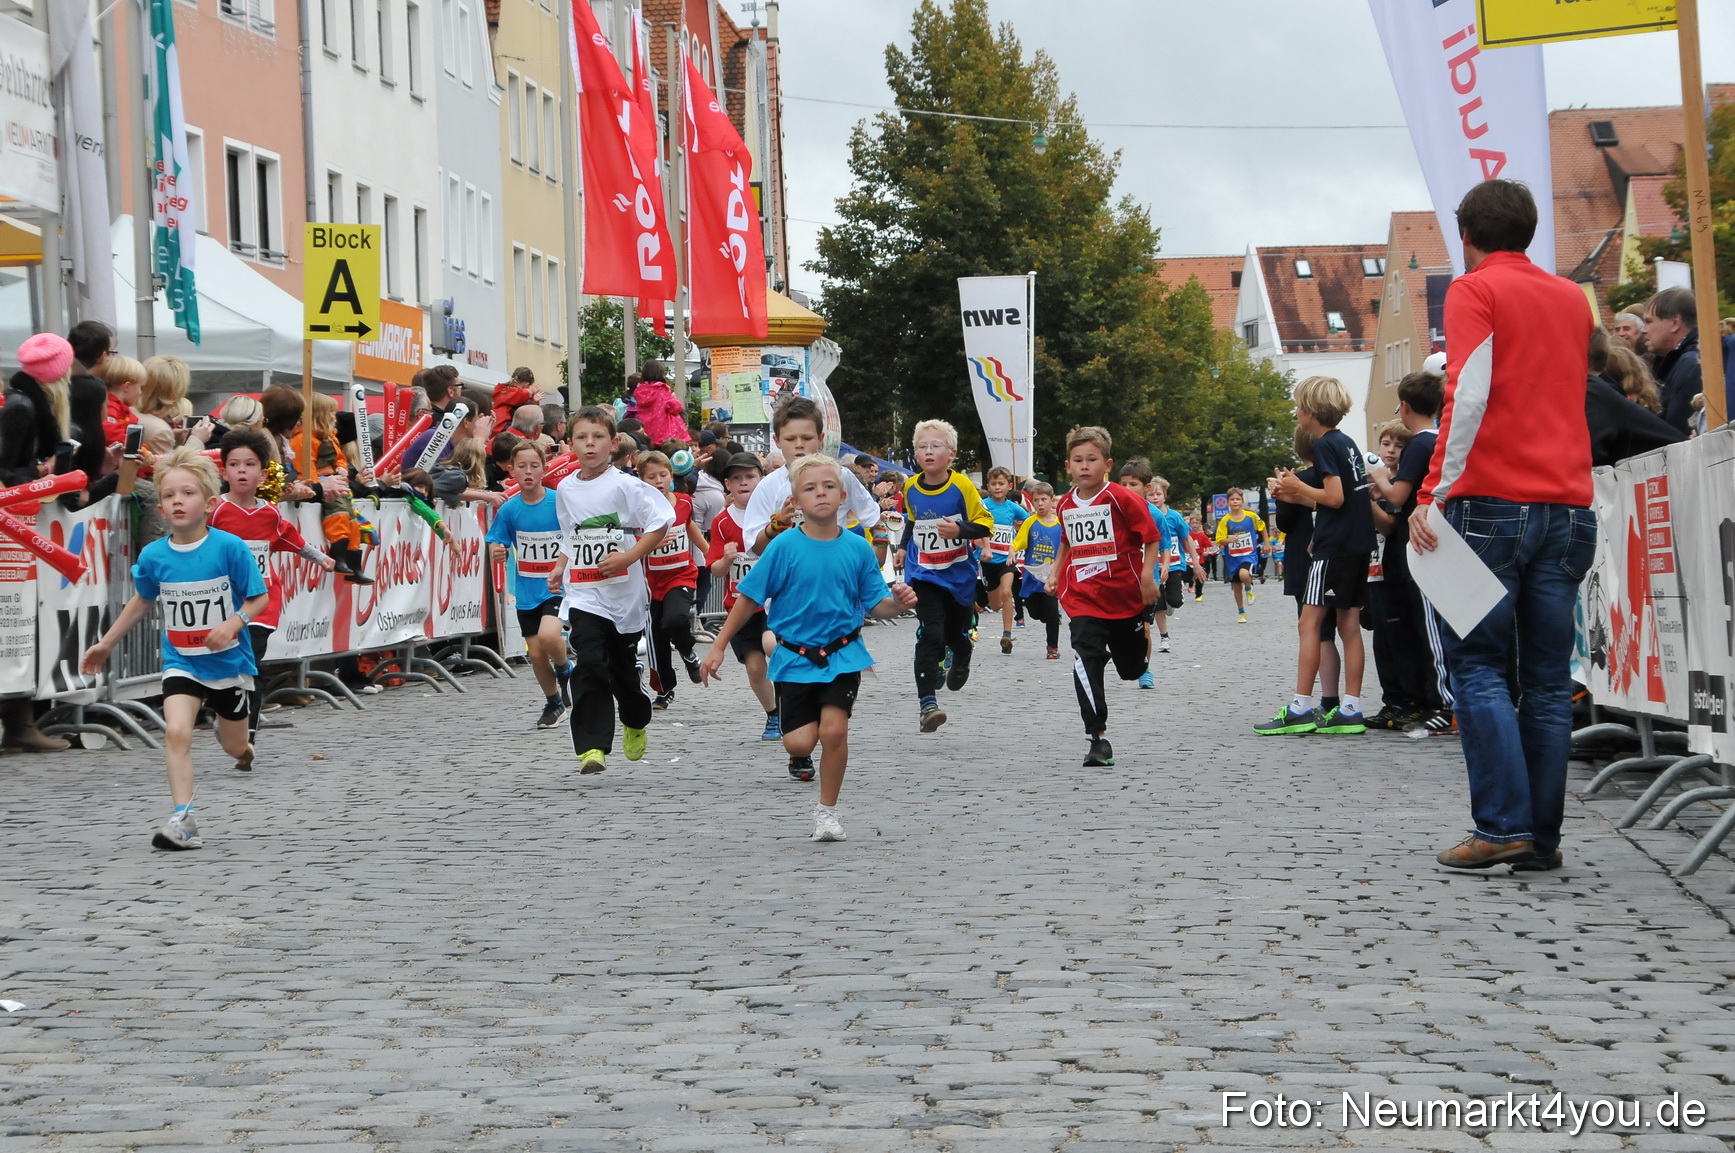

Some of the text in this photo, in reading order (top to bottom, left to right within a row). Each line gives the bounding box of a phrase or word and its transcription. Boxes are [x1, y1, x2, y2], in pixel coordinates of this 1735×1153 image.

[313, 228, 371, 249] Block
[319, 259, 363, 314] A
[427, 431, 445, 455] BMW
[1076, 511, 1101, 519] Neumarkt
[5, 519, 26, 534] BKK
[1068, 519, 1108, 543] 7034
[521, 542, 560, 560] 7112
[182, 586, 220, 597] Neumarkt
[167, 595, 227, 627] 7071
